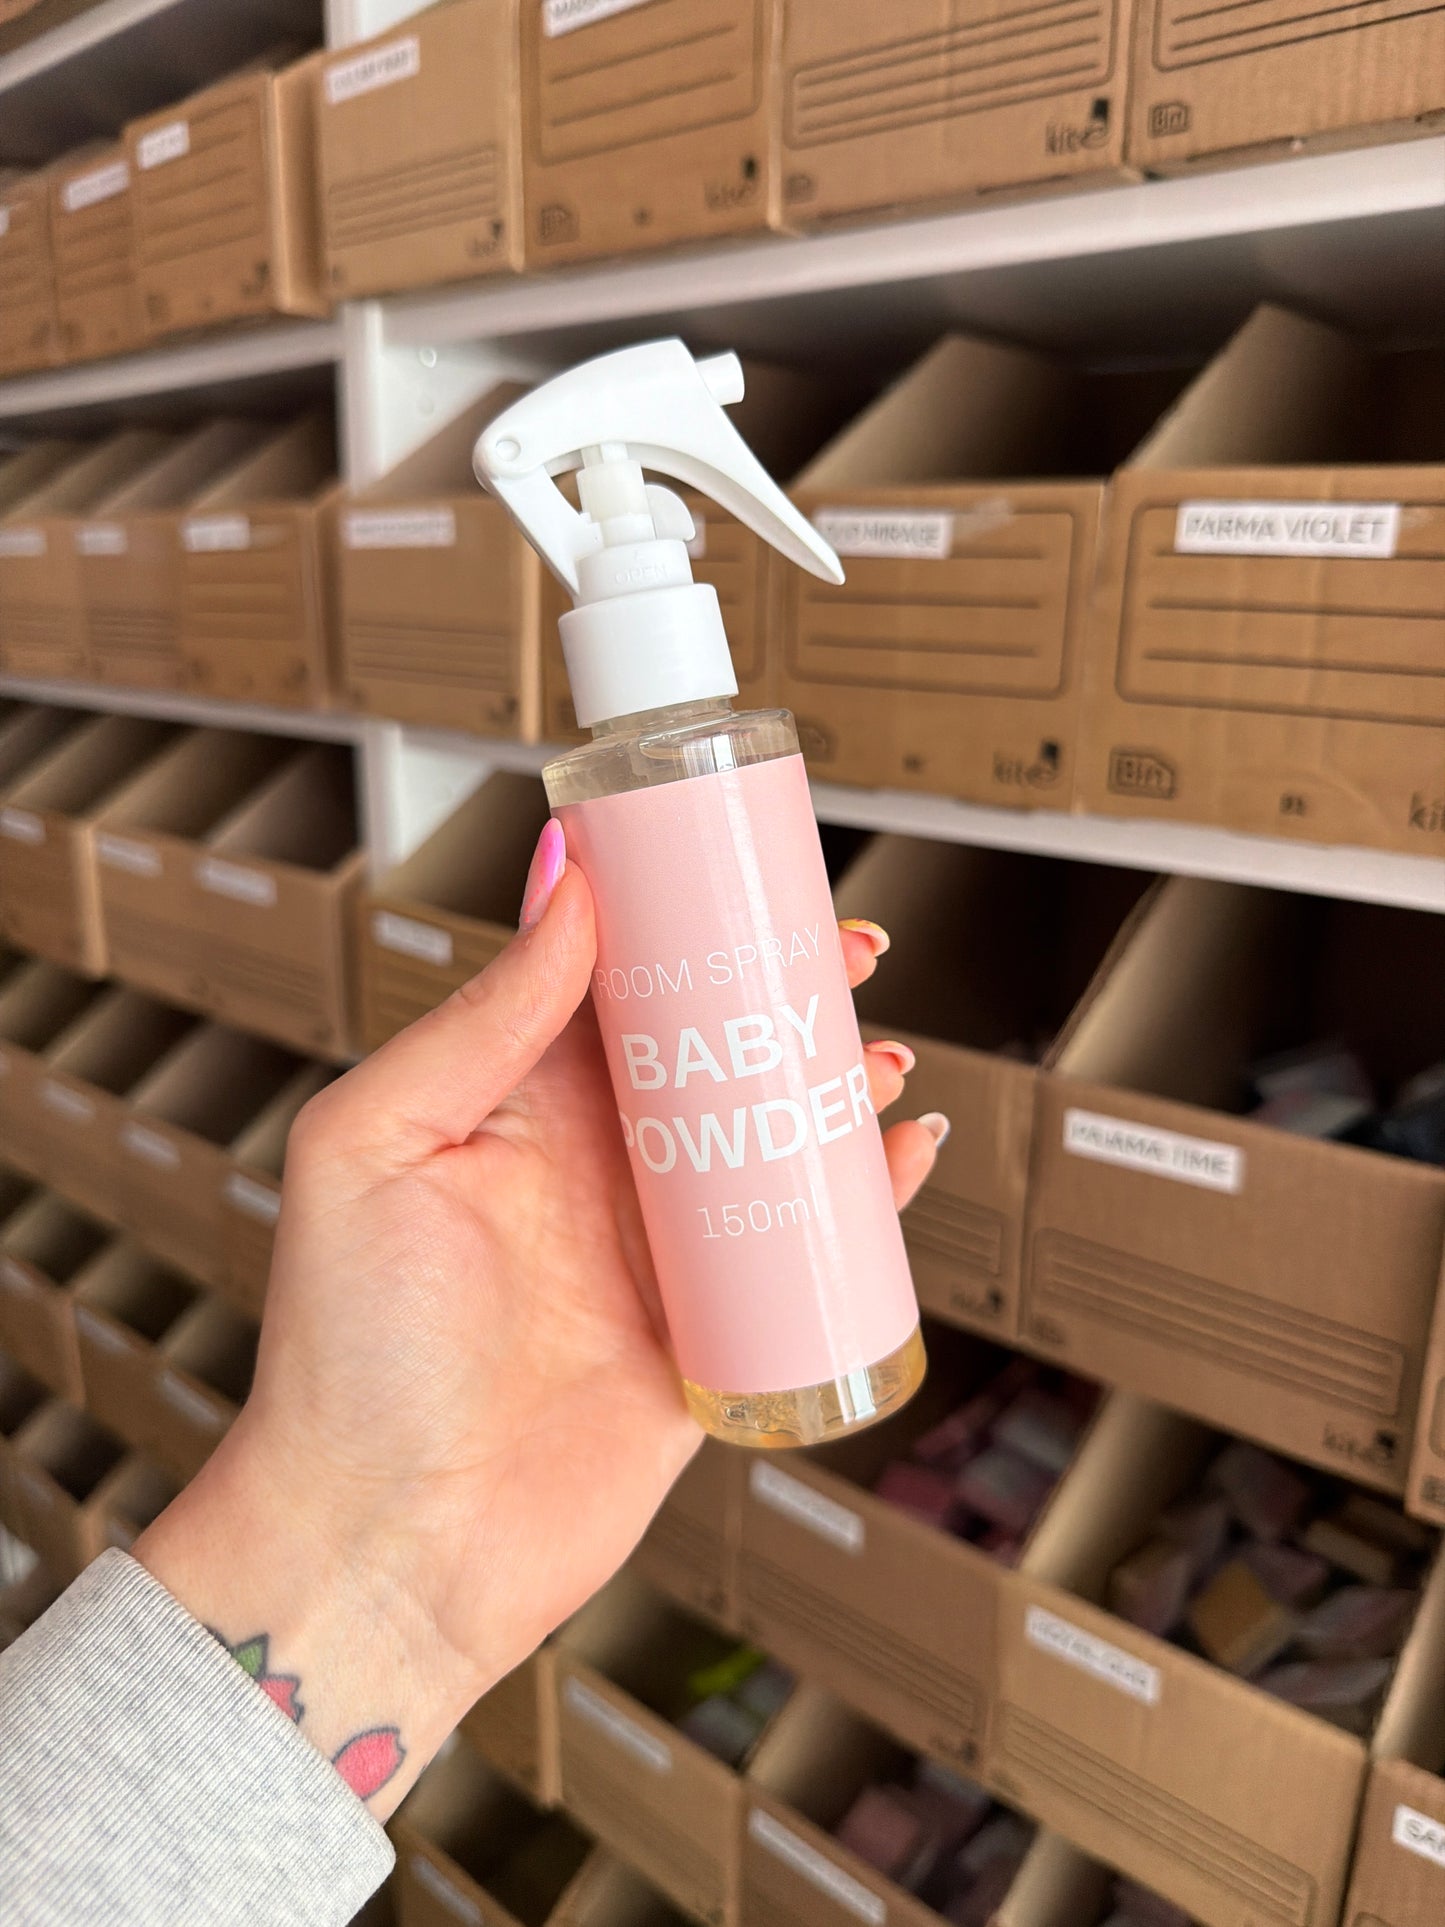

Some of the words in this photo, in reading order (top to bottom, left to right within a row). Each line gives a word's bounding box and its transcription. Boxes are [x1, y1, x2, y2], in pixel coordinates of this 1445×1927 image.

[1184, 510, 1275, 540] PARMA
[1283, 511, 1388, 545] VIOLET
[614, 562, 671, 585] OPEN
[595, 959, 693, 1000] ROOM
[706, 923, 820, 985] SPRAY
[621, 994, 820, 1091] BABY
[1170, 1145, 1229, 1175] TIME
[697, 1184, 821, 1239] 150ml
